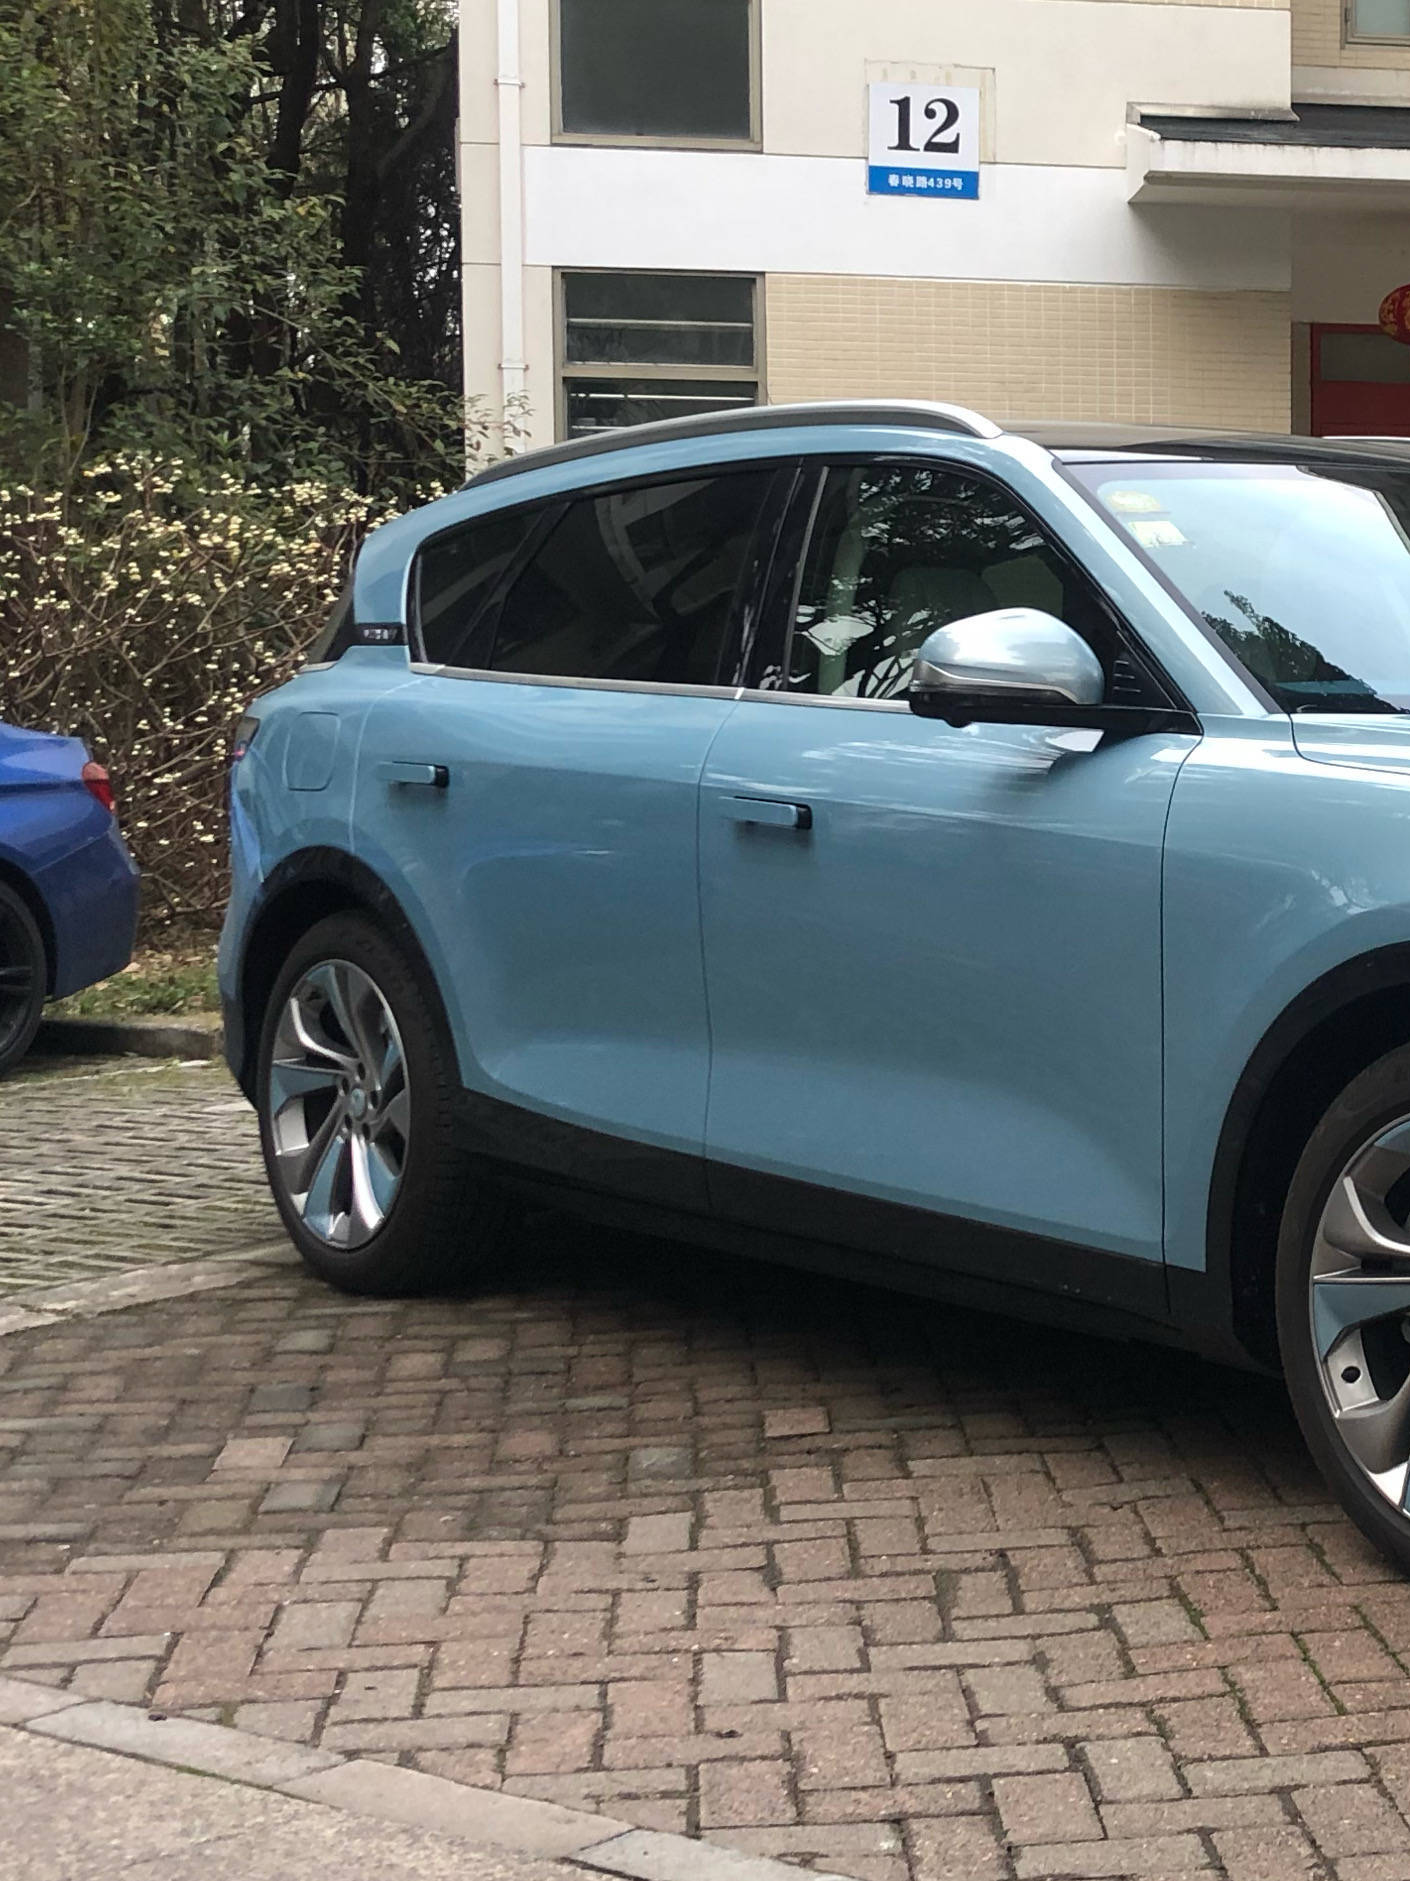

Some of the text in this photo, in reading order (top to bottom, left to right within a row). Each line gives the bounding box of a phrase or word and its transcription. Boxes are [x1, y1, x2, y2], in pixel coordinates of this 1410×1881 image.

[887, 96, 960, 153] 12
[888, 174, 963, 190] 春晓路439号
